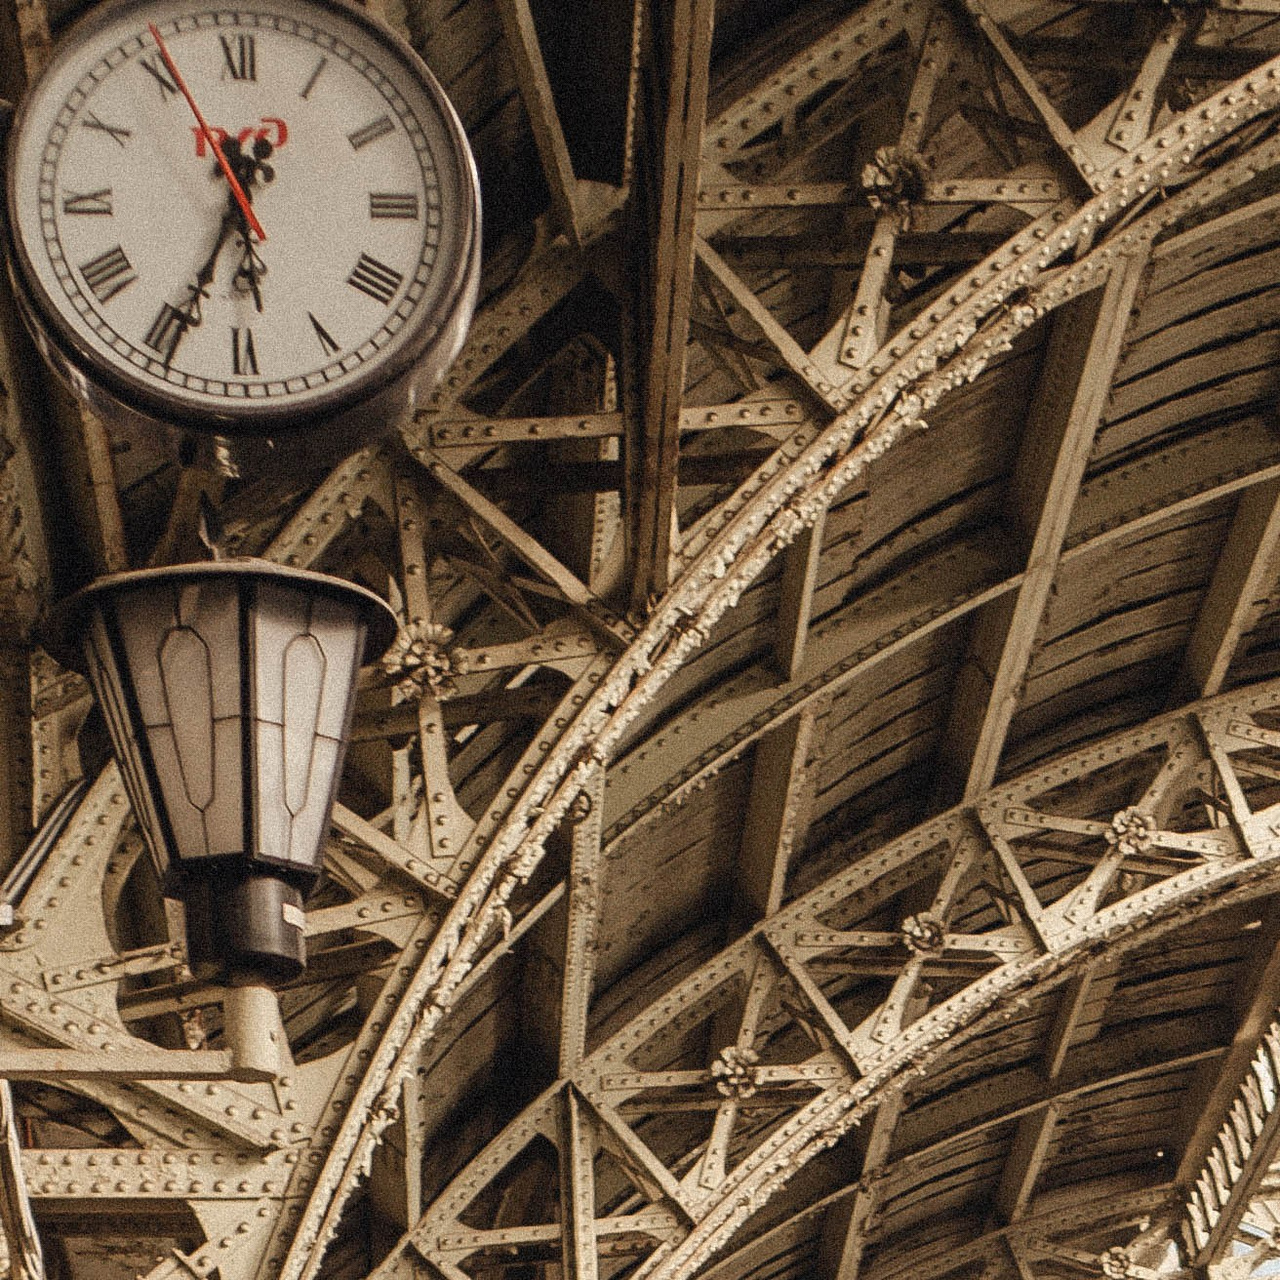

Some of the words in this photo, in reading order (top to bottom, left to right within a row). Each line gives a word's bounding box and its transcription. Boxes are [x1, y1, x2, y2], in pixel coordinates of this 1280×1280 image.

[219, 33, 257, 82] XII
[82, 110, 130, 148] X
[346, 114, 396, 151] II
[62, 187, 113, 217] IX
[369, 192, 420, 219] III
[347, 252, 405, 307] IIII
[307, 310, 342, 358] V
